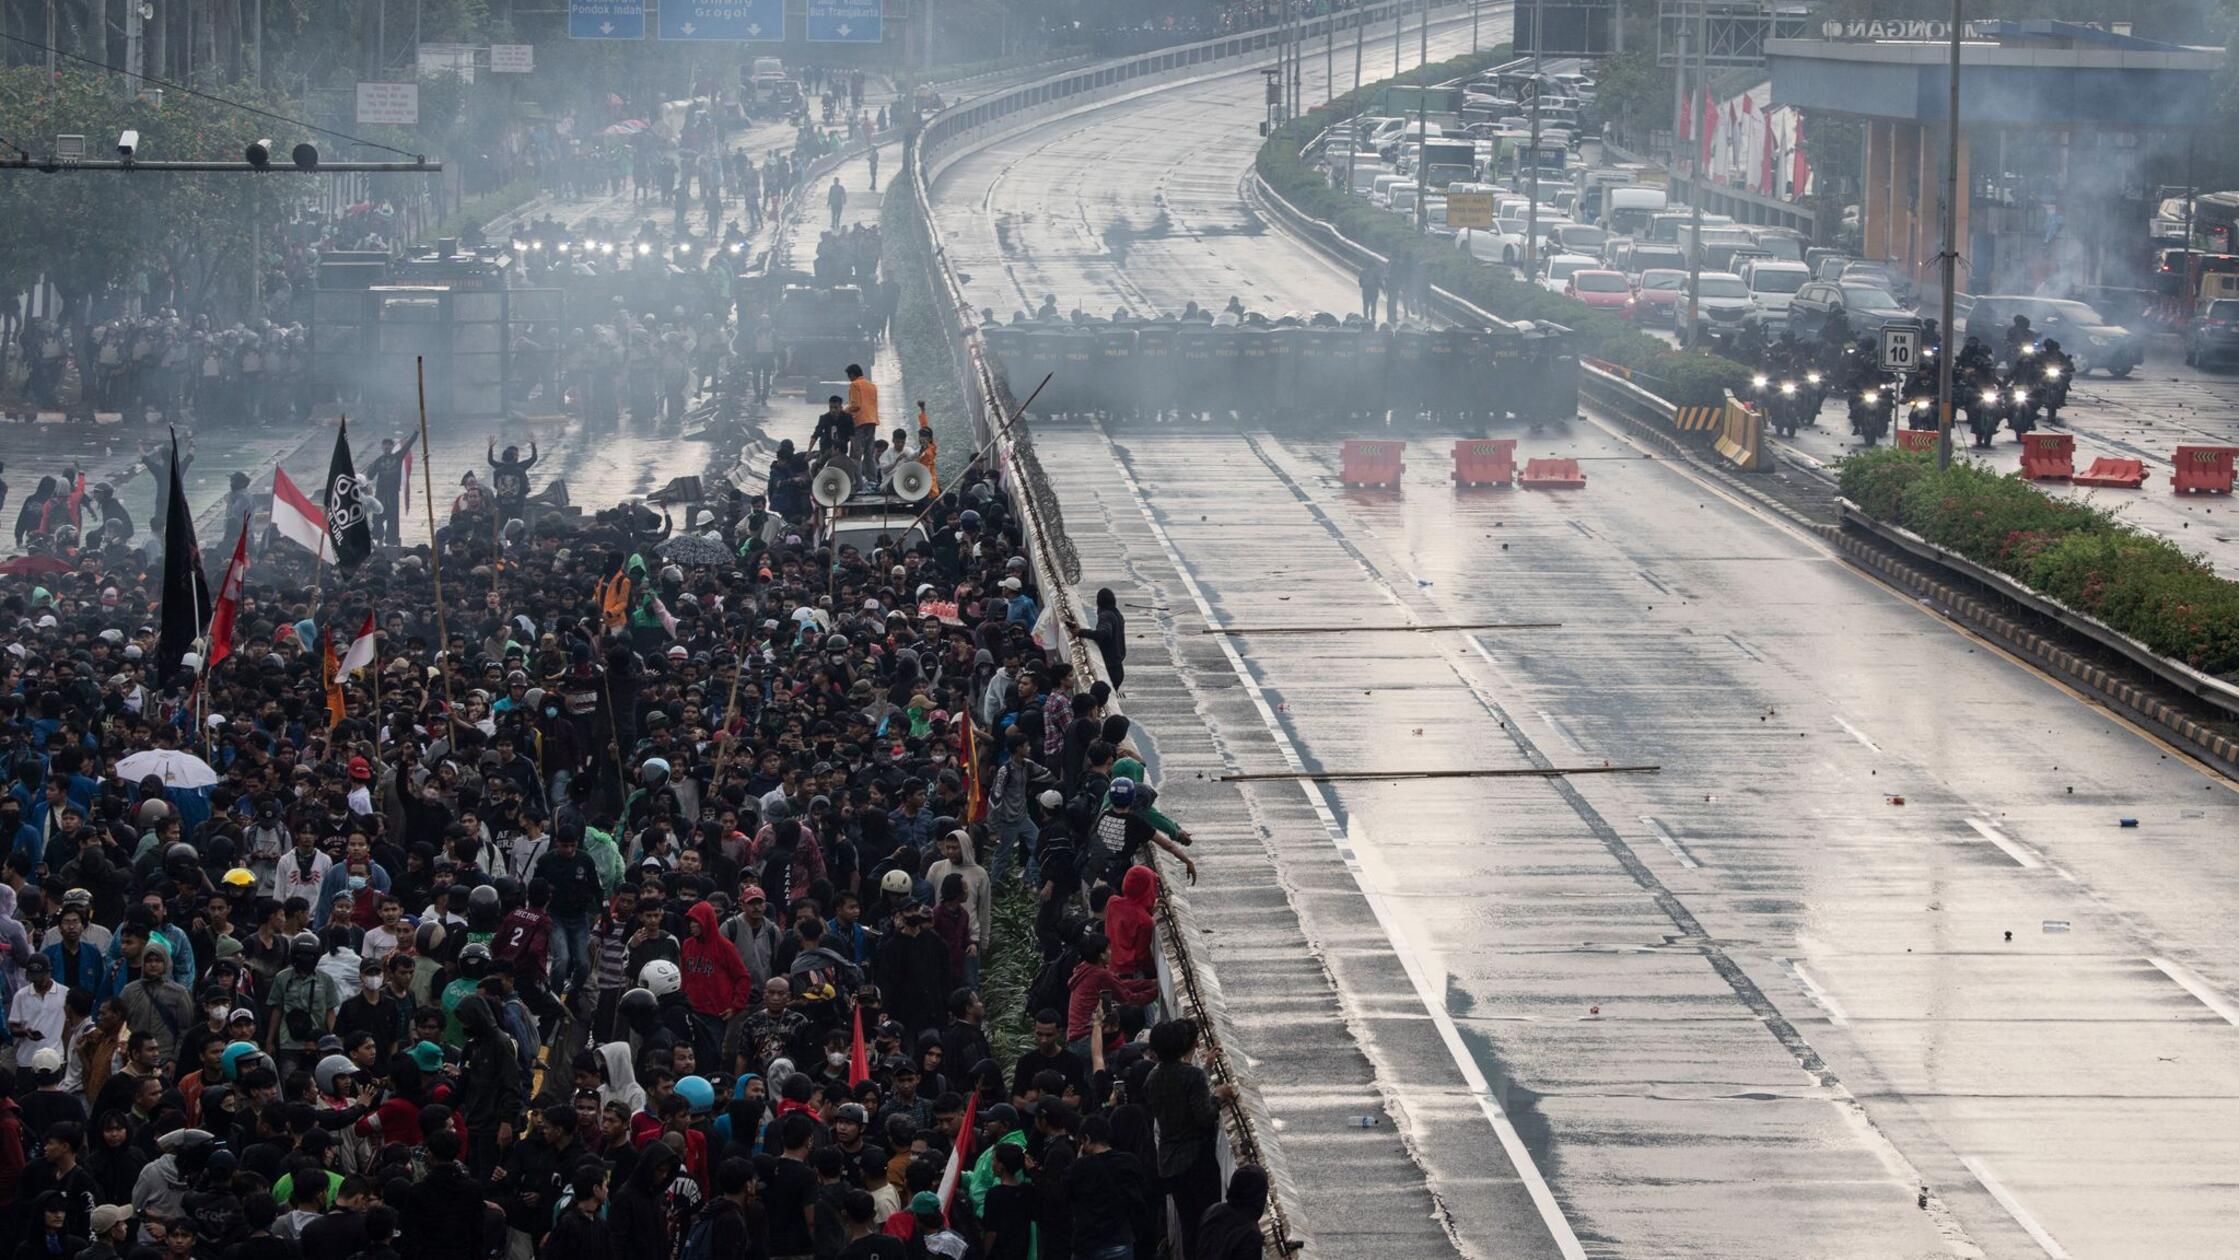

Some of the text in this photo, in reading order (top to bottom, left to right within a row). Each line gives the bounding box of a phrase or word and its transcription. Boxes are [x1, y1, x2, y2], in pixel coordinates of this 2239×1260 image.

[572, 4, 642, 15] Pondok Indah
[694, 8, 747, 20] Grogol
[1893, 336, 1906, 344] KM
[1890, 346, 1908, 362] 10
[510, 927, 524, 947] 2
